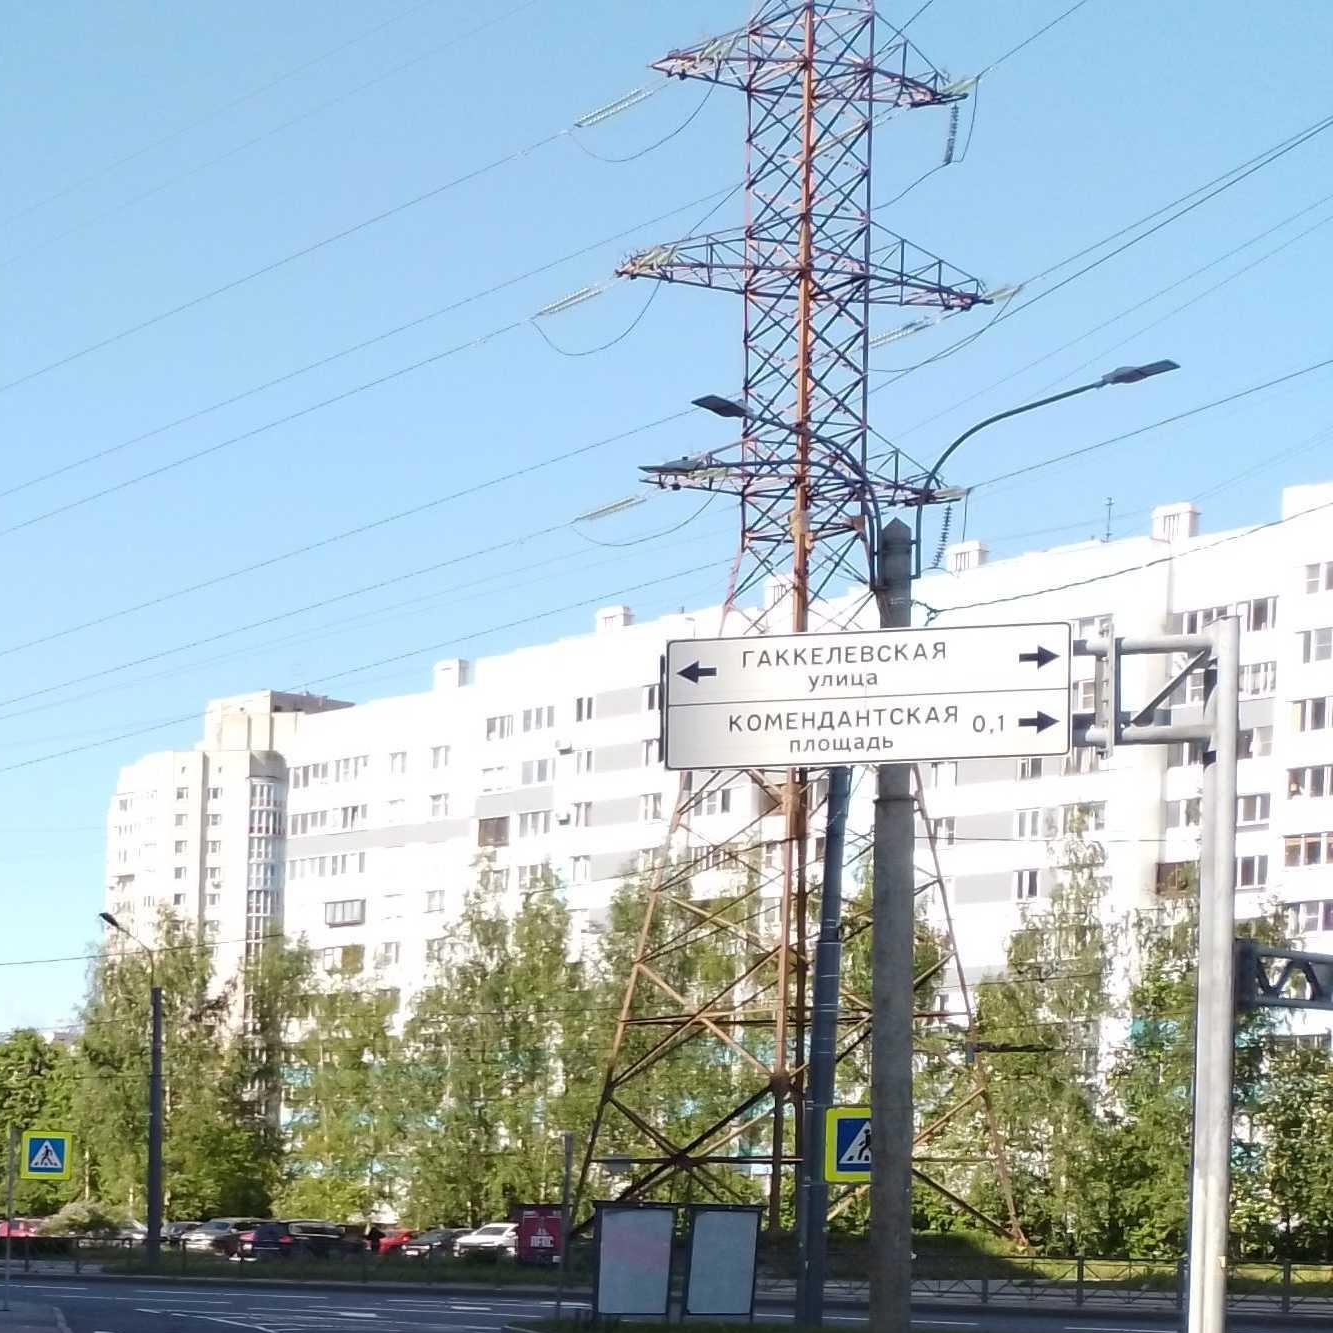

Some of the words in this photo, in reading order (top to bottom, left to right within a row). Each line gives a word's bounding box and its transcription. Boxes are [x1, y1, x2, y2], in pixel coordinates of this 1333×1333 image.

[741, 641, 947, 668] ГАККЕЛЕВСКАЯ
[808, 673, 878, 692] улица
[728, 705, 958, 732] КОМЕНДАНТСКАЯ
[972, 714, 1005, 734] 0,1
[789, 736, 894, 753] площадь
